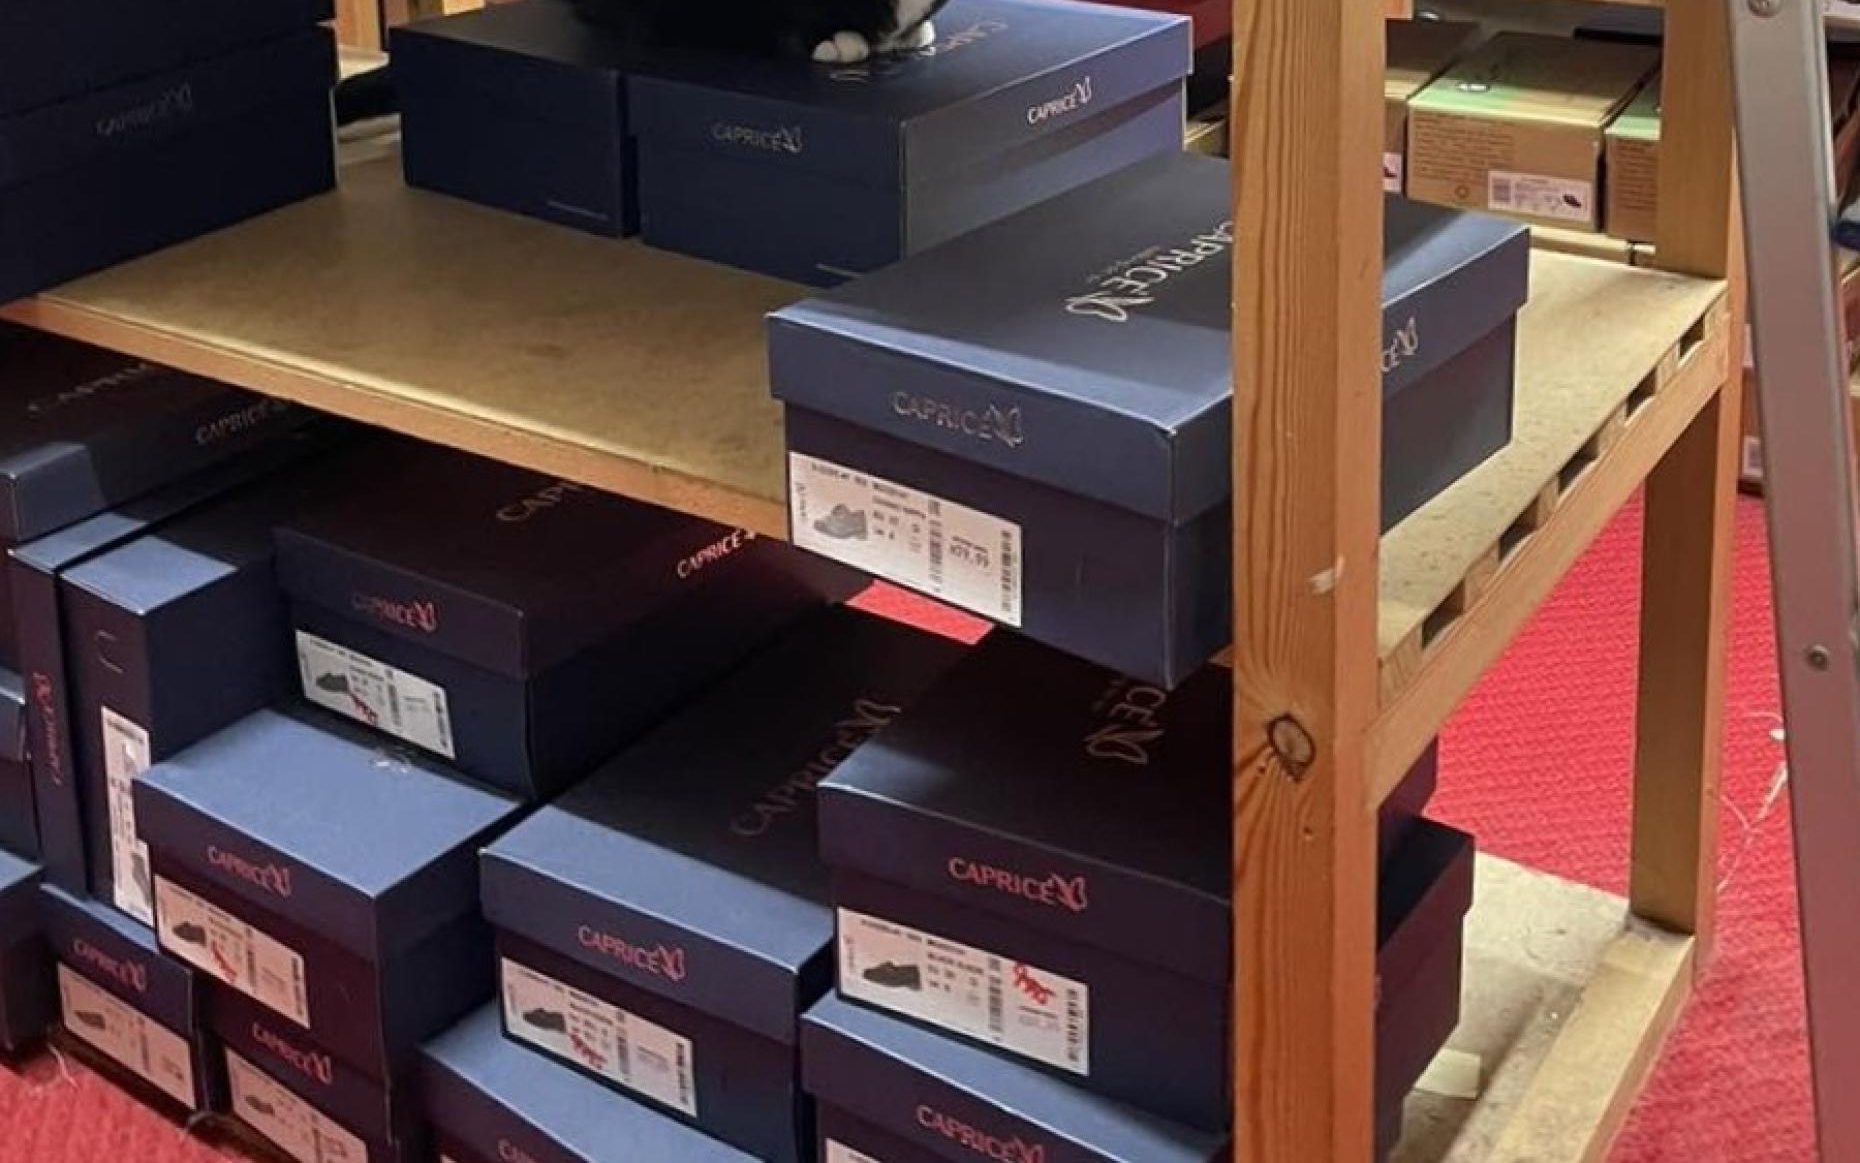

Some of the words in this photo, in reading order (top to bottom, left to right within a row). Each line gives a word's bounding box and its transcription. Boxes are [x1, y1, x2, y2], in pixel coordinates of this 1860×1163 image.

[1027, 94, 1078, 125] CAPRICE
[712, 122, 782, 152] CAPRICE
[894, 391, 991, 438] CAPRICE
[678, 529, 742, 579] CAPRICE
[208, 845, 267, 887] CAPRICE
[948, 856, 1054, 904] CAPRICE
[578, 925, 659, 973] CAPRICE
[915, 1104, 1013, 1160] CAPRICE
